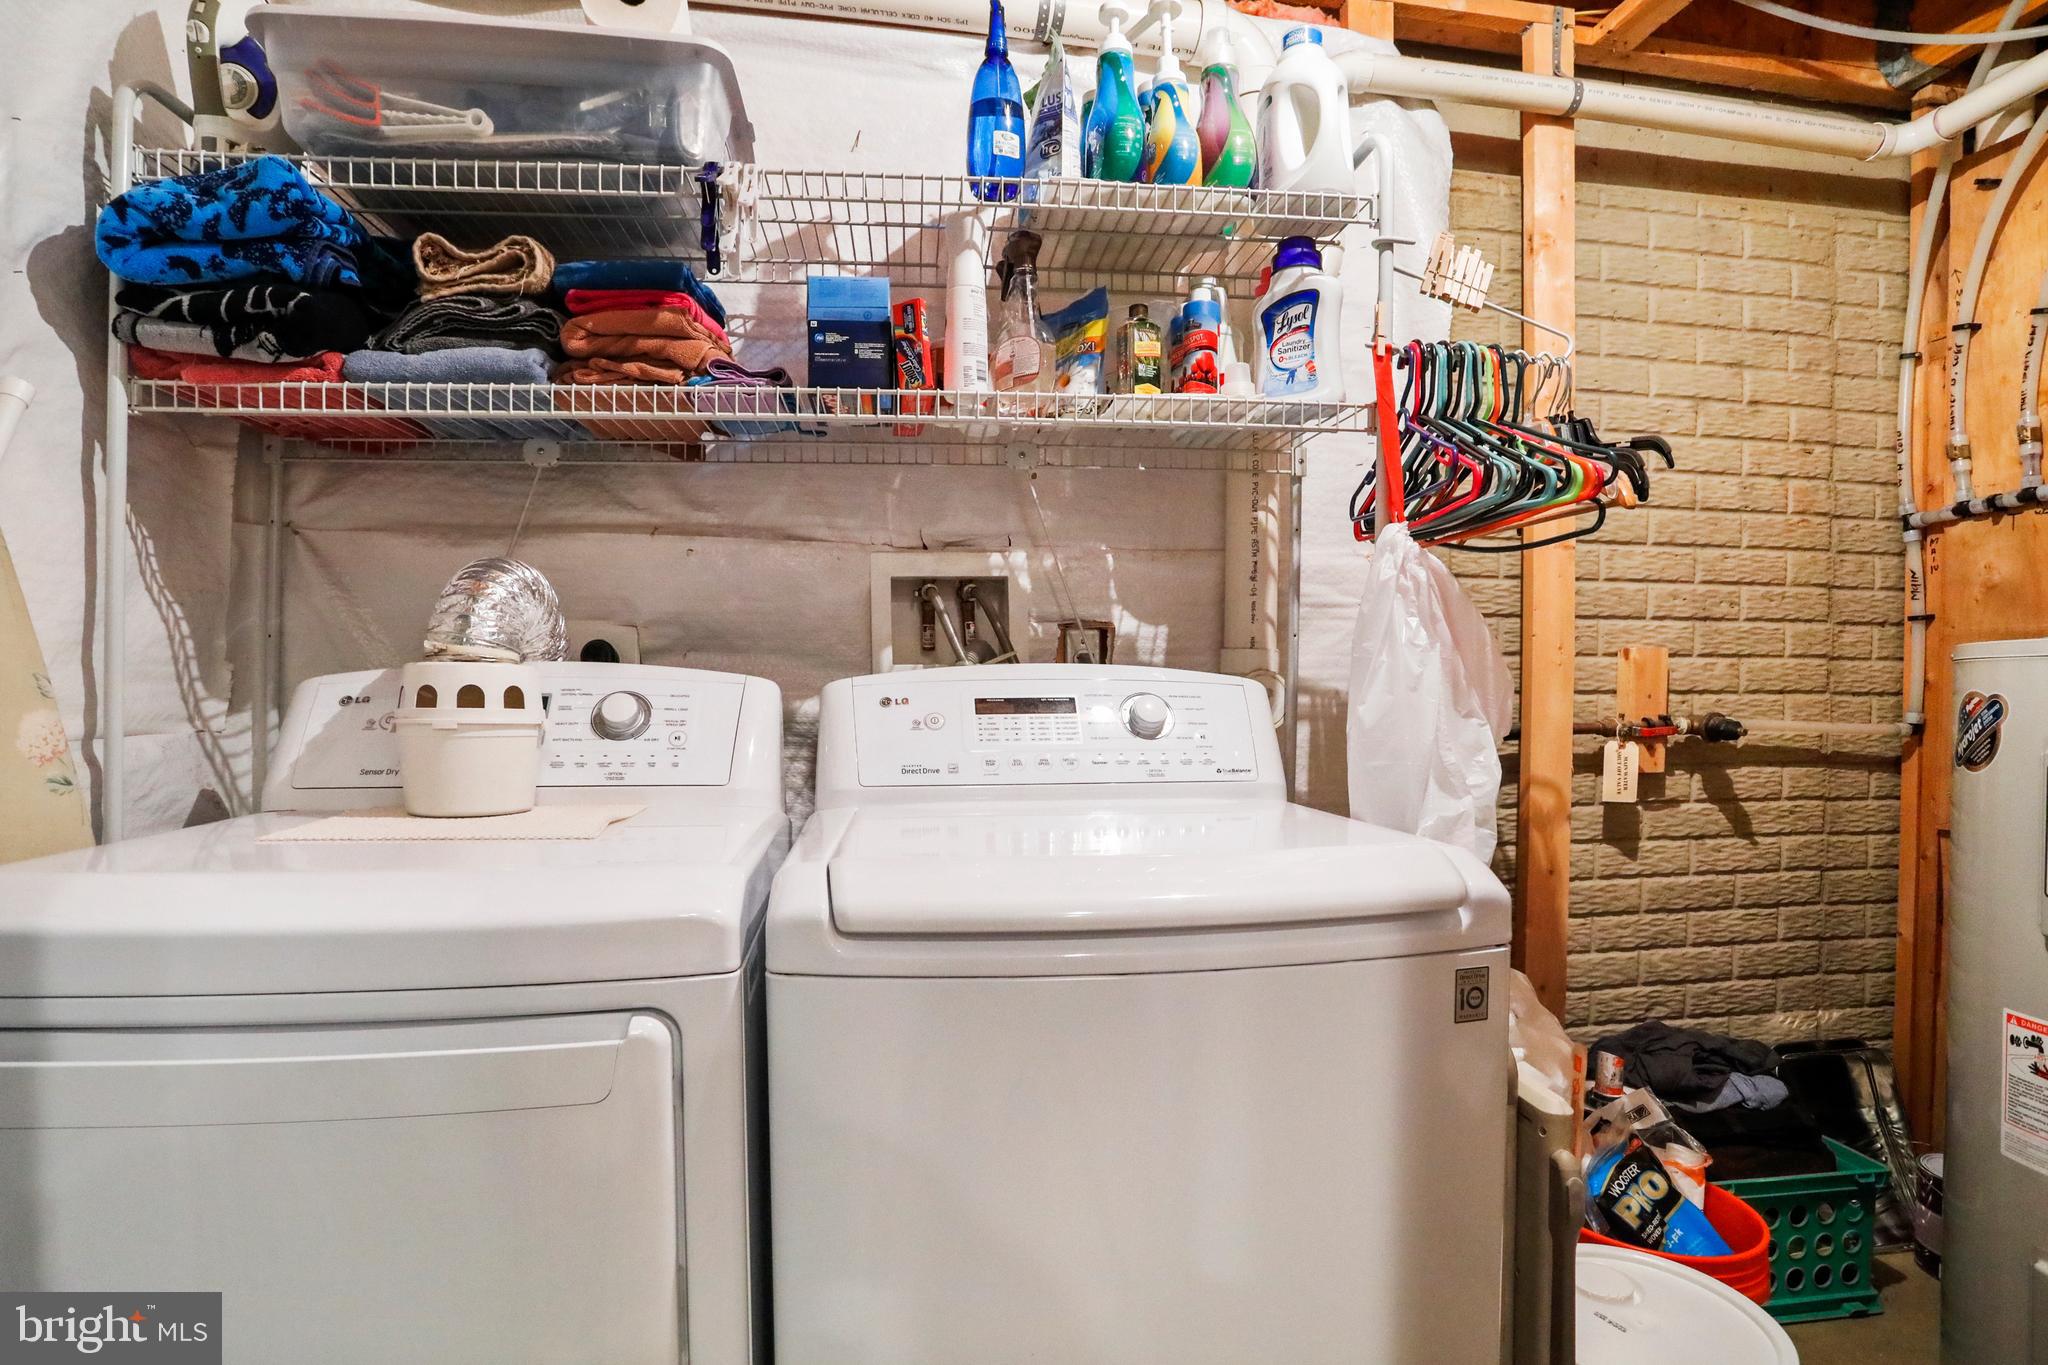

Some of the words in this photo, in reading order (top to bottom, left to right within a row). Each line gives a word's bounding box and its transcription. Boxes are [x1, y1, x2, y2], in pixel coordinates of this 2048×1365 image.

[1276, 304, 1310, 334] Lysol
[1278, 344, 1311, 355] Sanitizer
[1282, 338, 1306, 347] Laundry
[354, 696, 371, 704] LG
[895, 697, 910, 705] LG
[1460, 986, 1484, 1011] 10
[1608, 1162, 1641, 1198] WOOSTER
[1612, 1170, 1670, 1230] PRO
